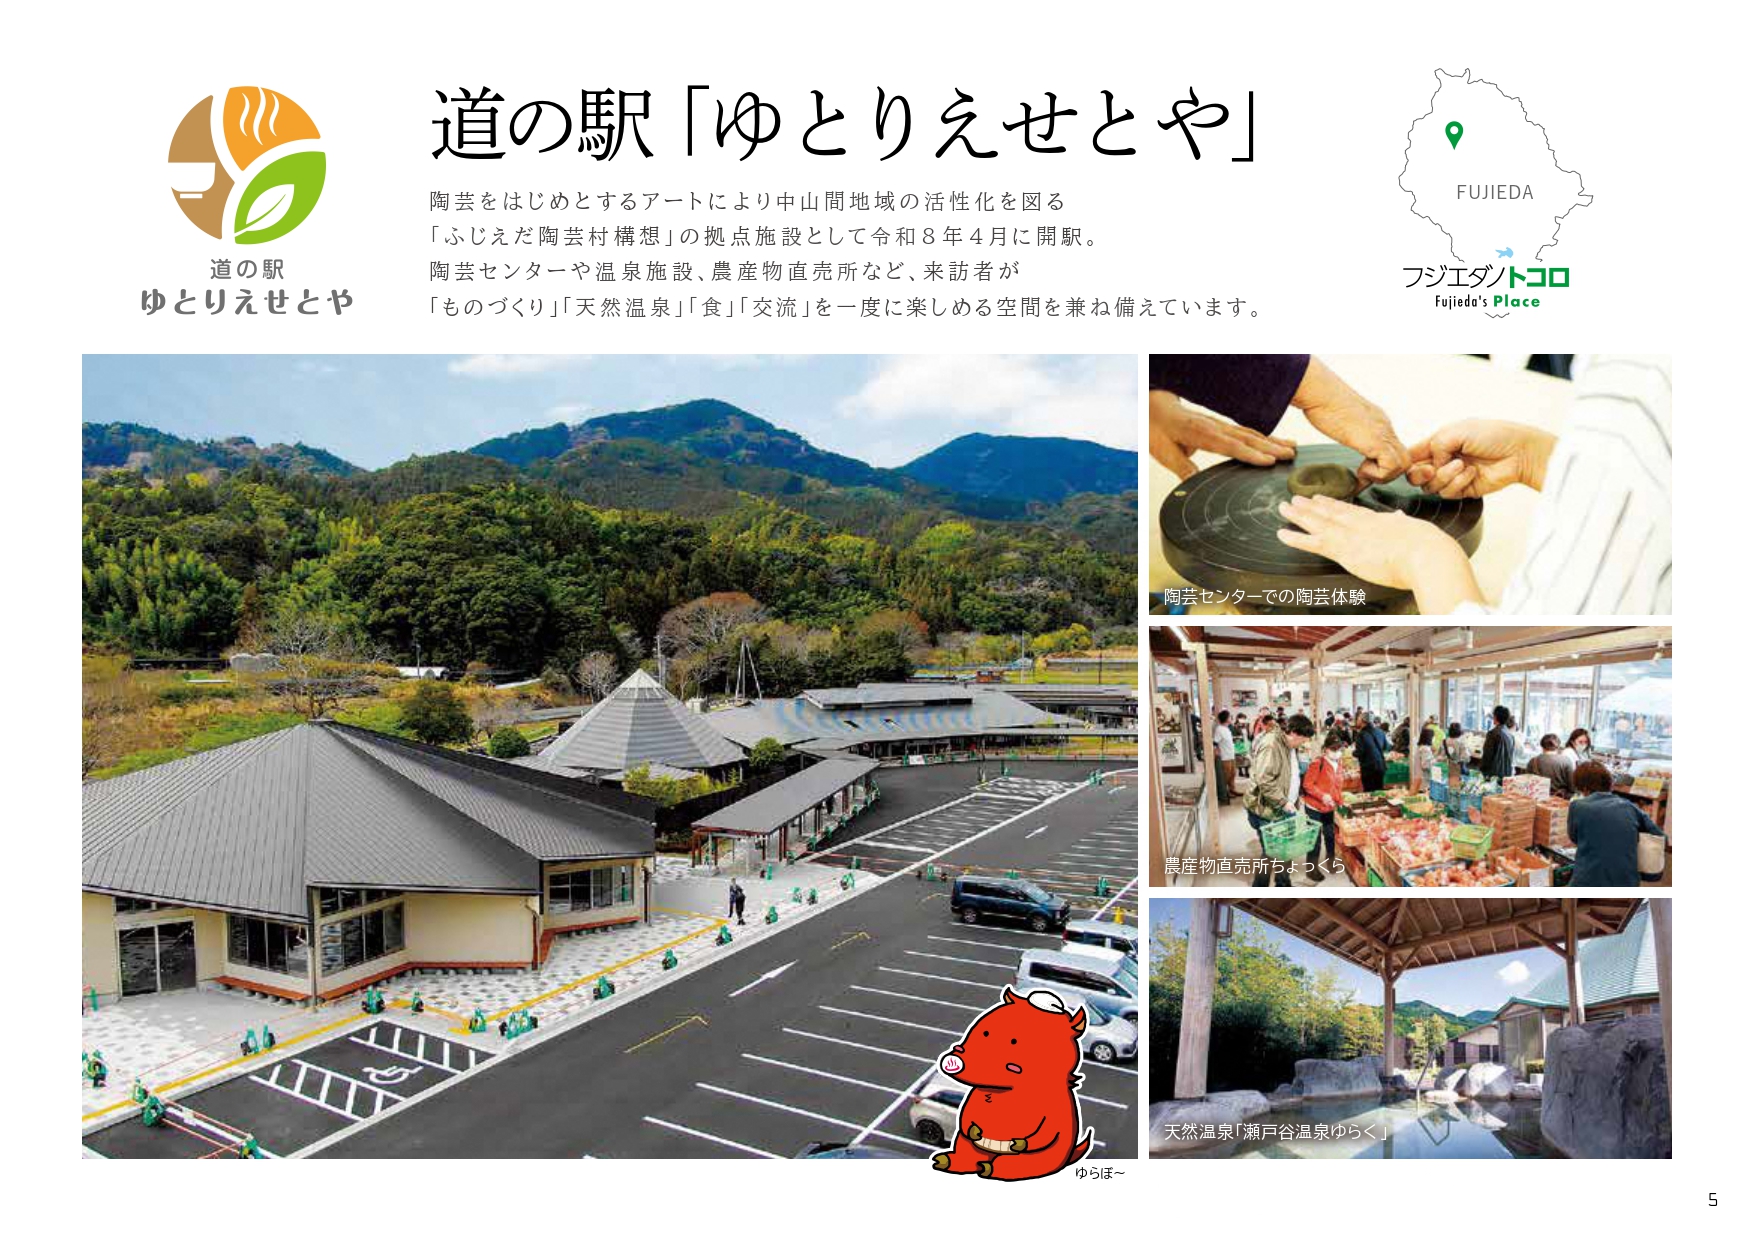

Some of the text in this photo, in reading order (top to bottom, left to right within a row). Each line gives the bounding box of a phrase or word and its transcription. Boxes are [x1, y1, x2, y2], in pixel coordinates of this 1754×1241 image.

[431, 84, 1254, 163] 道の駅「ゆとりえせとや」
[430, 190, 1064, 212] 陶芸をはじめとするアートにより中山間地域の活性化を図る
[1457, 184, 1534, 200] FUJIEDA
[210, 258, 284, 280] 道の駅
[430, 260, 1020, 282] 陶芸センターや温泉施設、農産物直売所など、来訪者が
[1402, 263, 1570, 289] フジエダノトコロ
[141, 288, 353, 316] ゆとりえせとや
[1435, 294, 1541, 311] Fujieda's Place
[1708, 1192, 1718, 1207] 5
